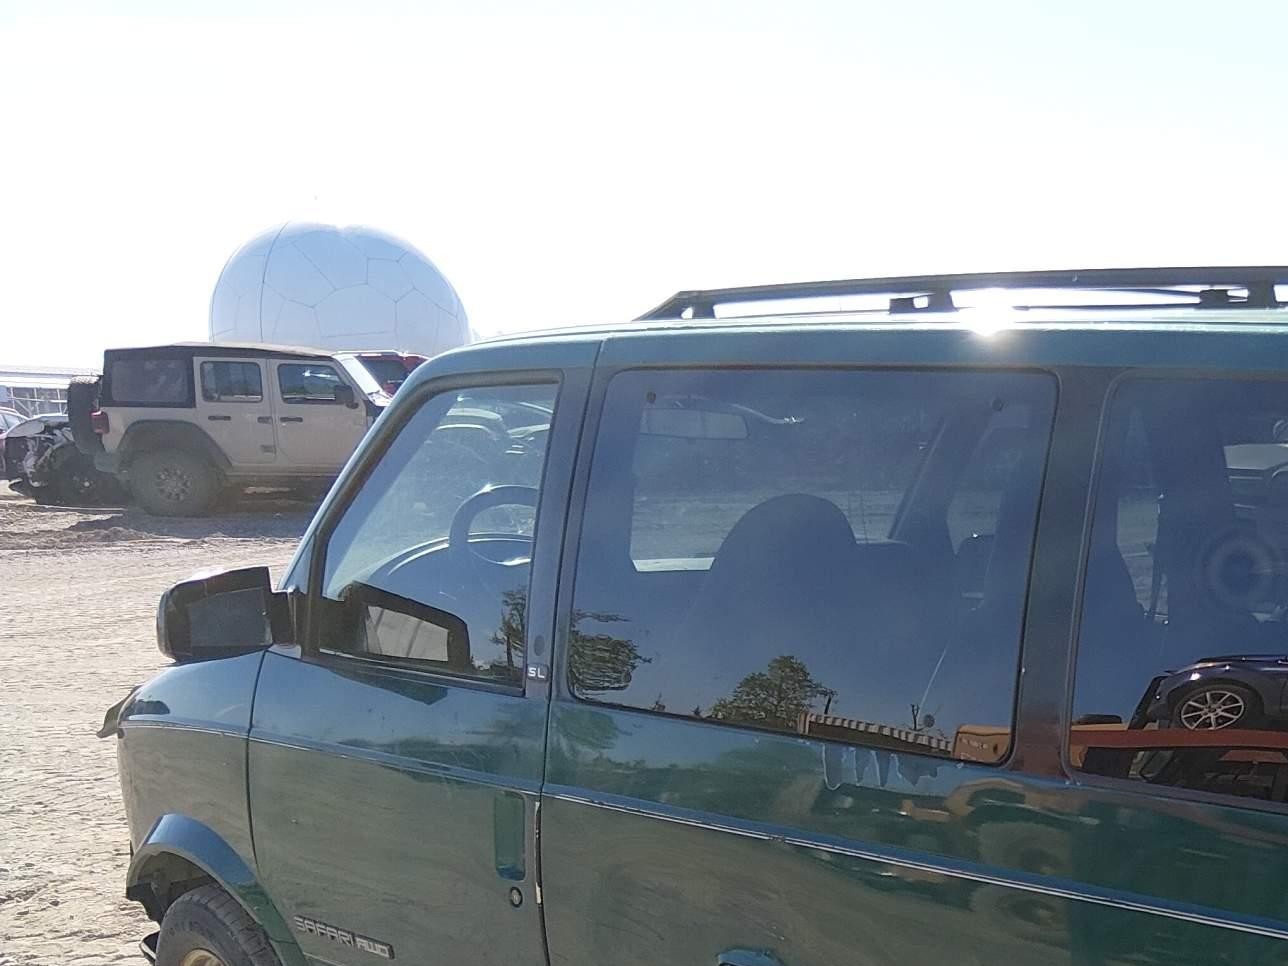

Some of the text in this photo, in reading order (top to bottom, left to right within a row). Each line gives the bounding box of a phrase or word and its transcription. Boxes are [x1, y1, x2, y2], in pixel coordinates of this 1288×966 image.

[528, 667, 545, 678] SL
[293, 915, 391, 960] SAFARI AWD
